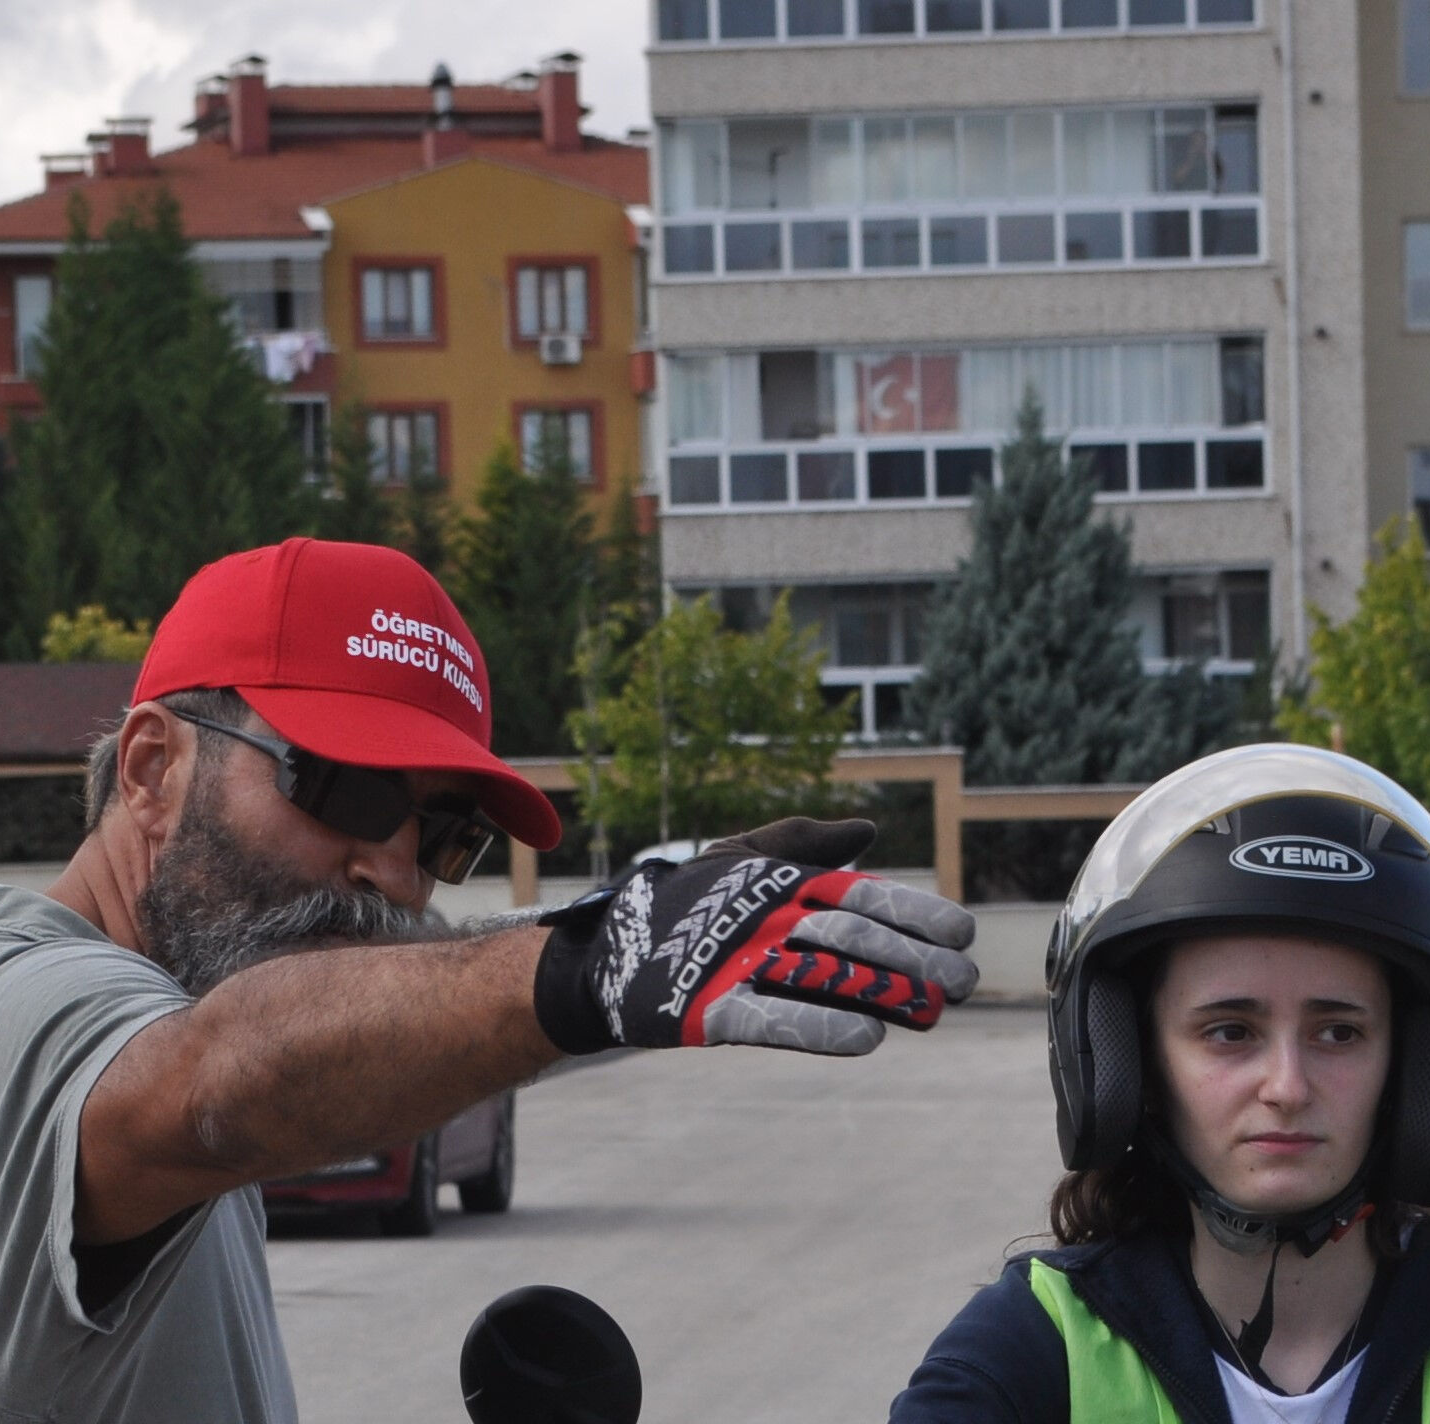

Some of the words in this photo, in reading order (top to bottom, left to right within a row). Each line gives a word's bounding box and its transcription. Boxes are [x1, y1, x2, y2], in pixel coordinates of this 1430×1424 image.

[371, 609, 473, 671] ÖĞRETMEN
[347, 634, 438, 672] SÜRÜCÜ
[443, 660, 482, 712] KURSU
[1260, 846, 1349, 871] YEMA
